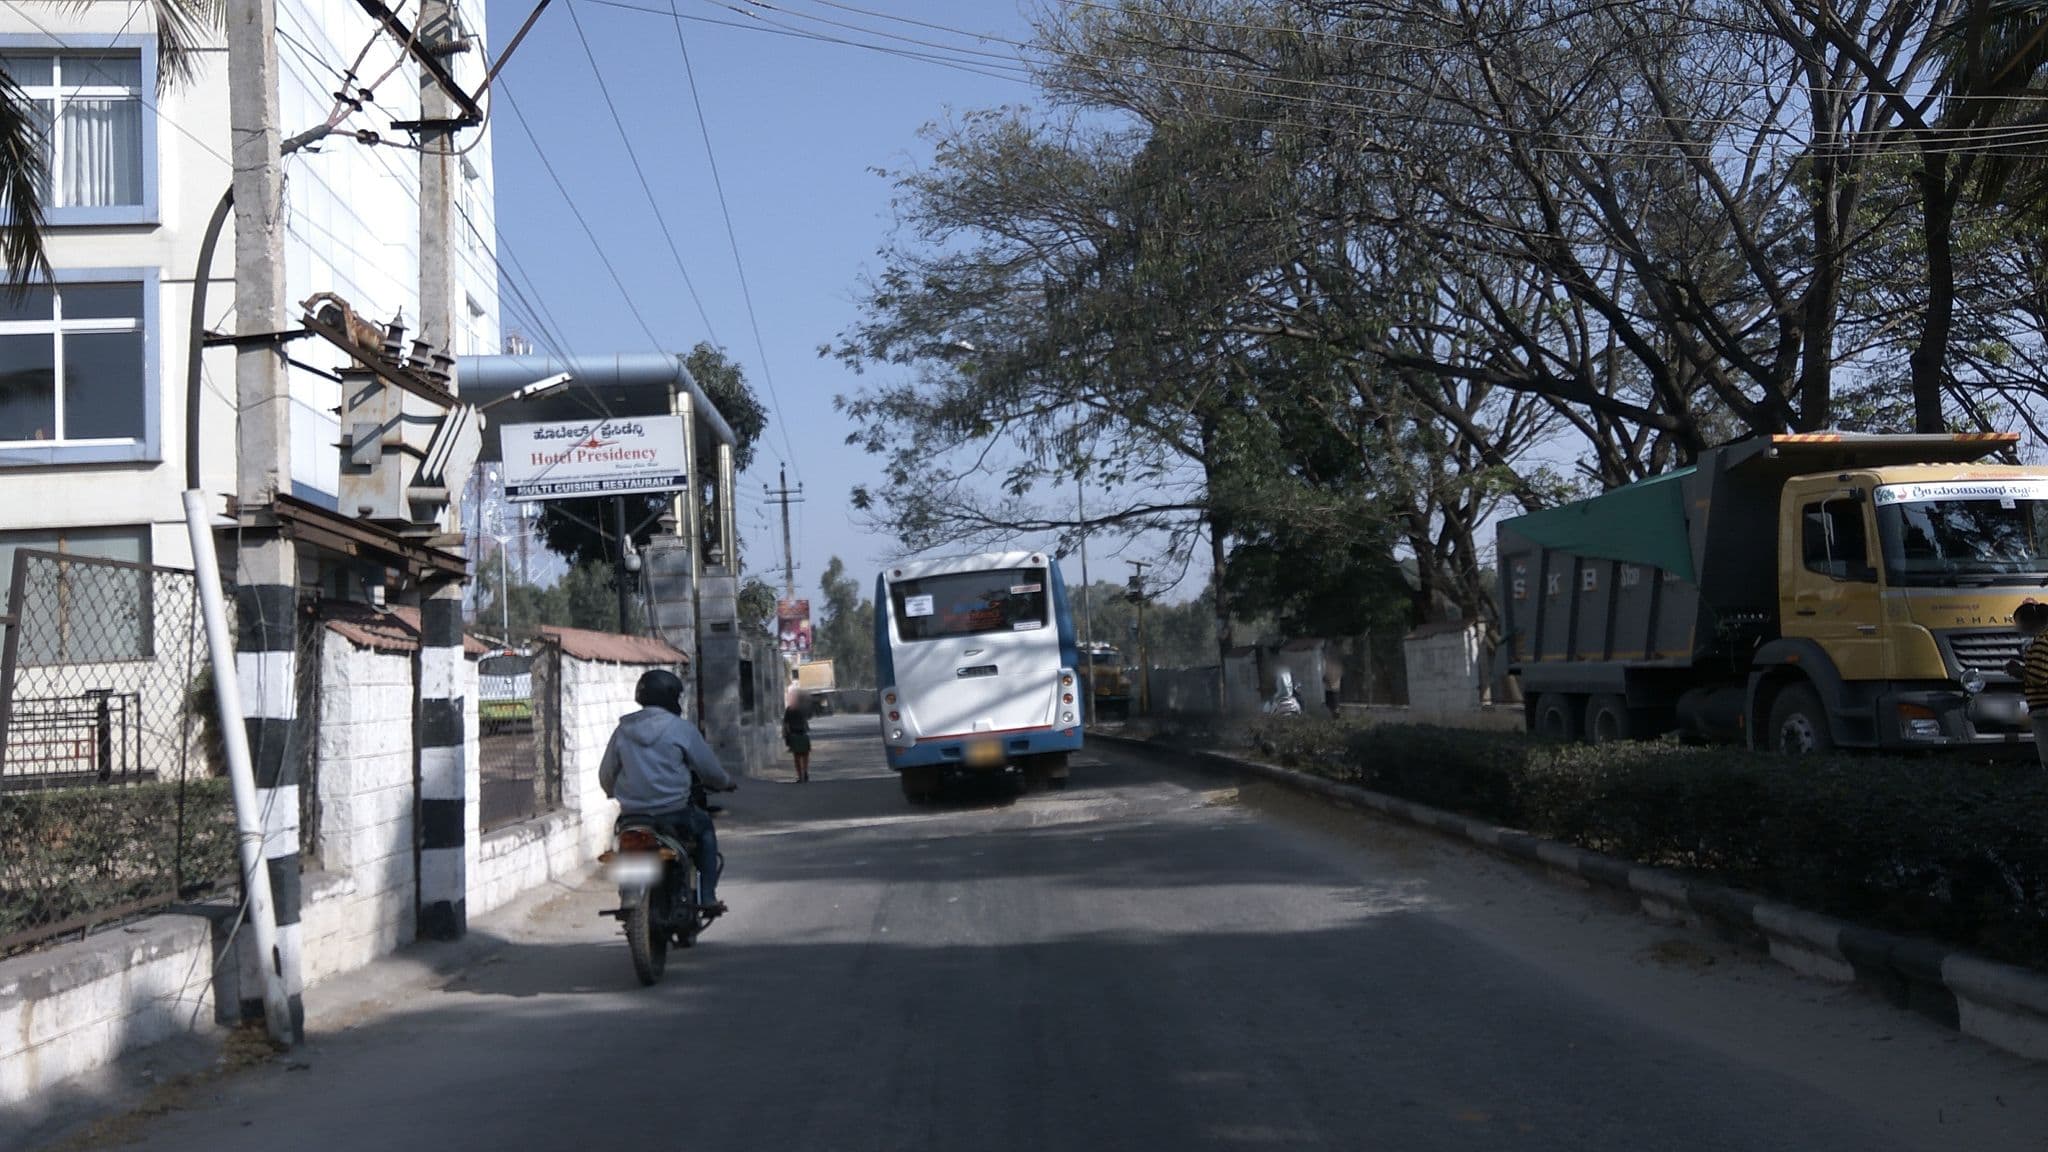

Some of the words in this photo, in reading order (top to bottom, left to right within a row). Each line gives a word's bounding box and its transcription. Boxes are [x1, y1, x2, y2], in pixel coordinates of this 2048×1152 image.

[531, 450, 571, 466] Hotel
[577, 447, 657, 463] Presidency
[517, 485, 552, 496] MULTI
[555, 481, 600, 493] CUISINE
[602, 476, 675, 490] RESTAURANT
